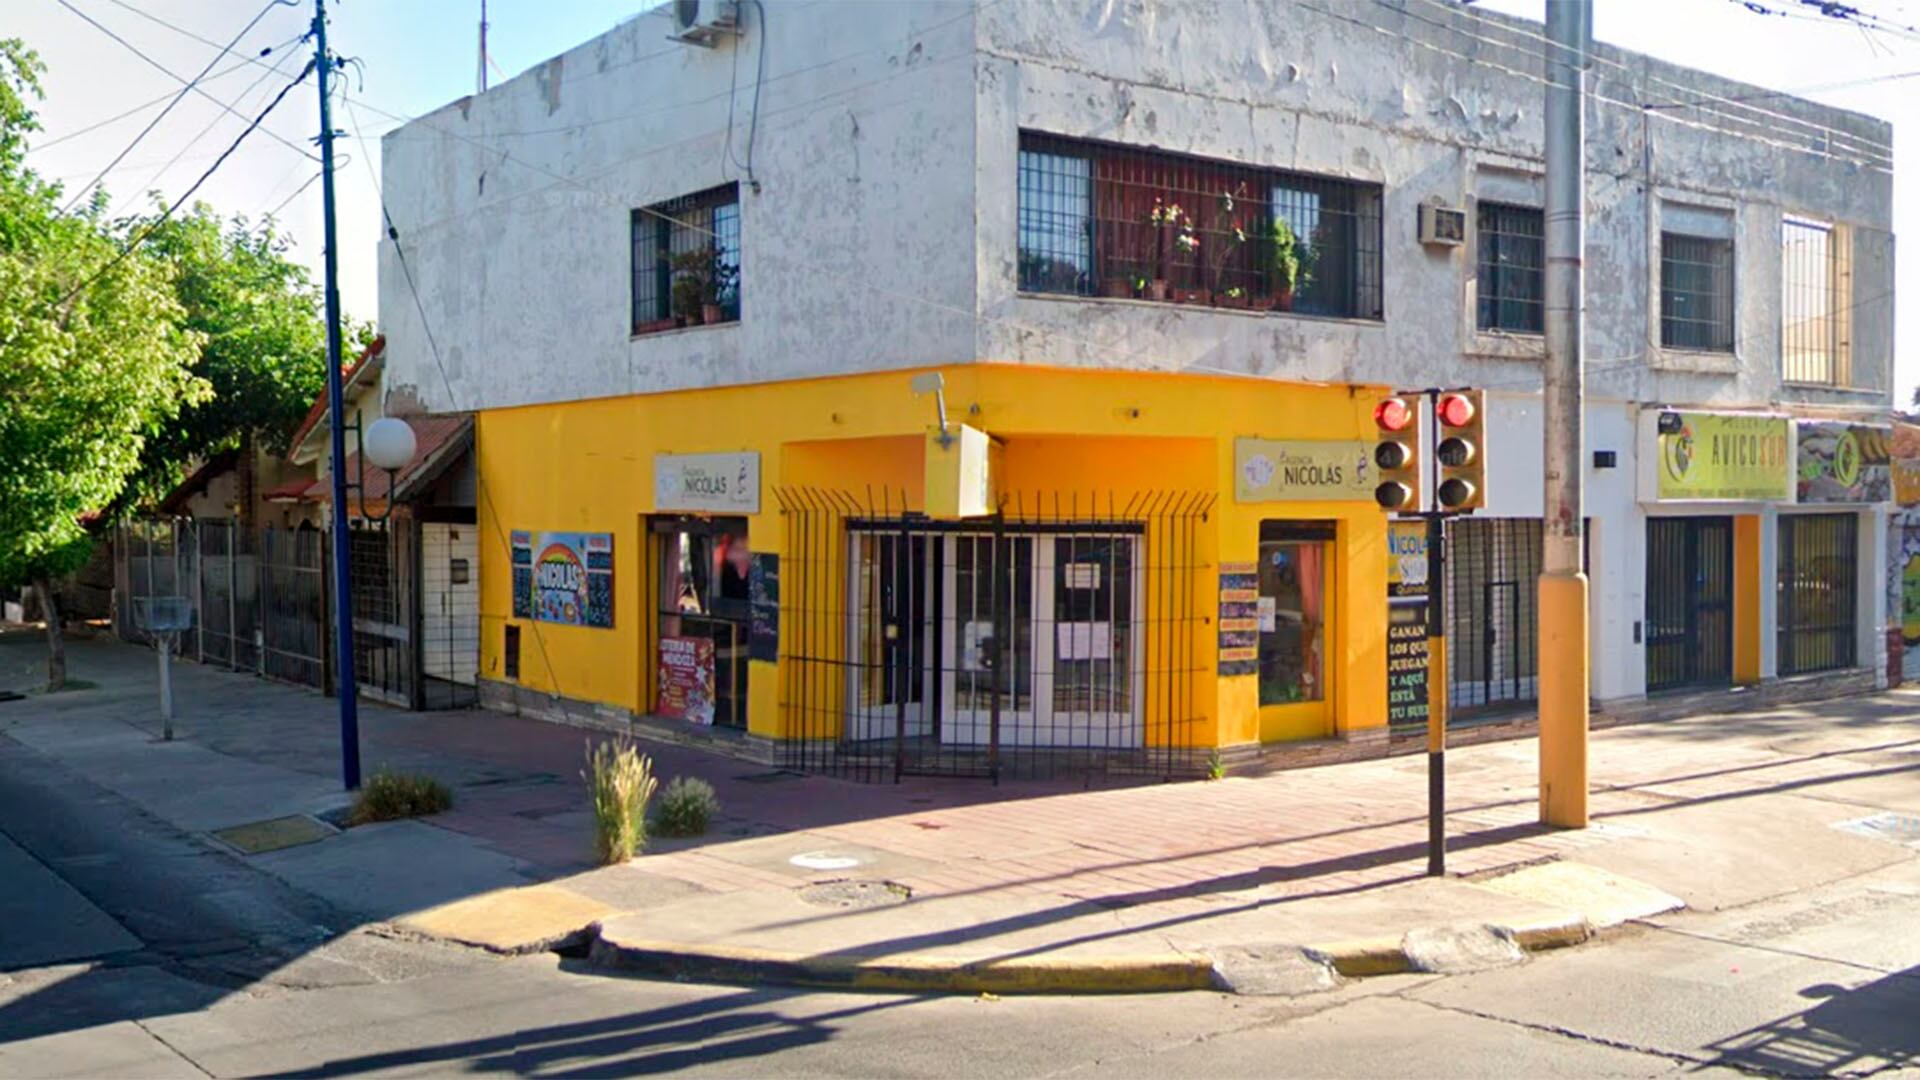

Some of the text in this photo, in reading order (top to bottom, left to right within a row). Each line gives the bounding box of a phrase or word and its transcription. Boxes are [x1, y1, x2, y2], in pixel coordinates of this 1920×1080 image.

[1711, 434, 1785, 465] AVICOSUR
[1284, 461, 1343, 485] NICOLÁS
[685, 472, 727, 495] NICOLÁS
[1390, 625, 1426, 638] GANAN
[1389, 643, 1408, 655] LOS
[1389, 657, 1429, 671] JUEGAN
[1390, 675, 1398, 687] Y
[1390, 707, 1406, 719] TU
